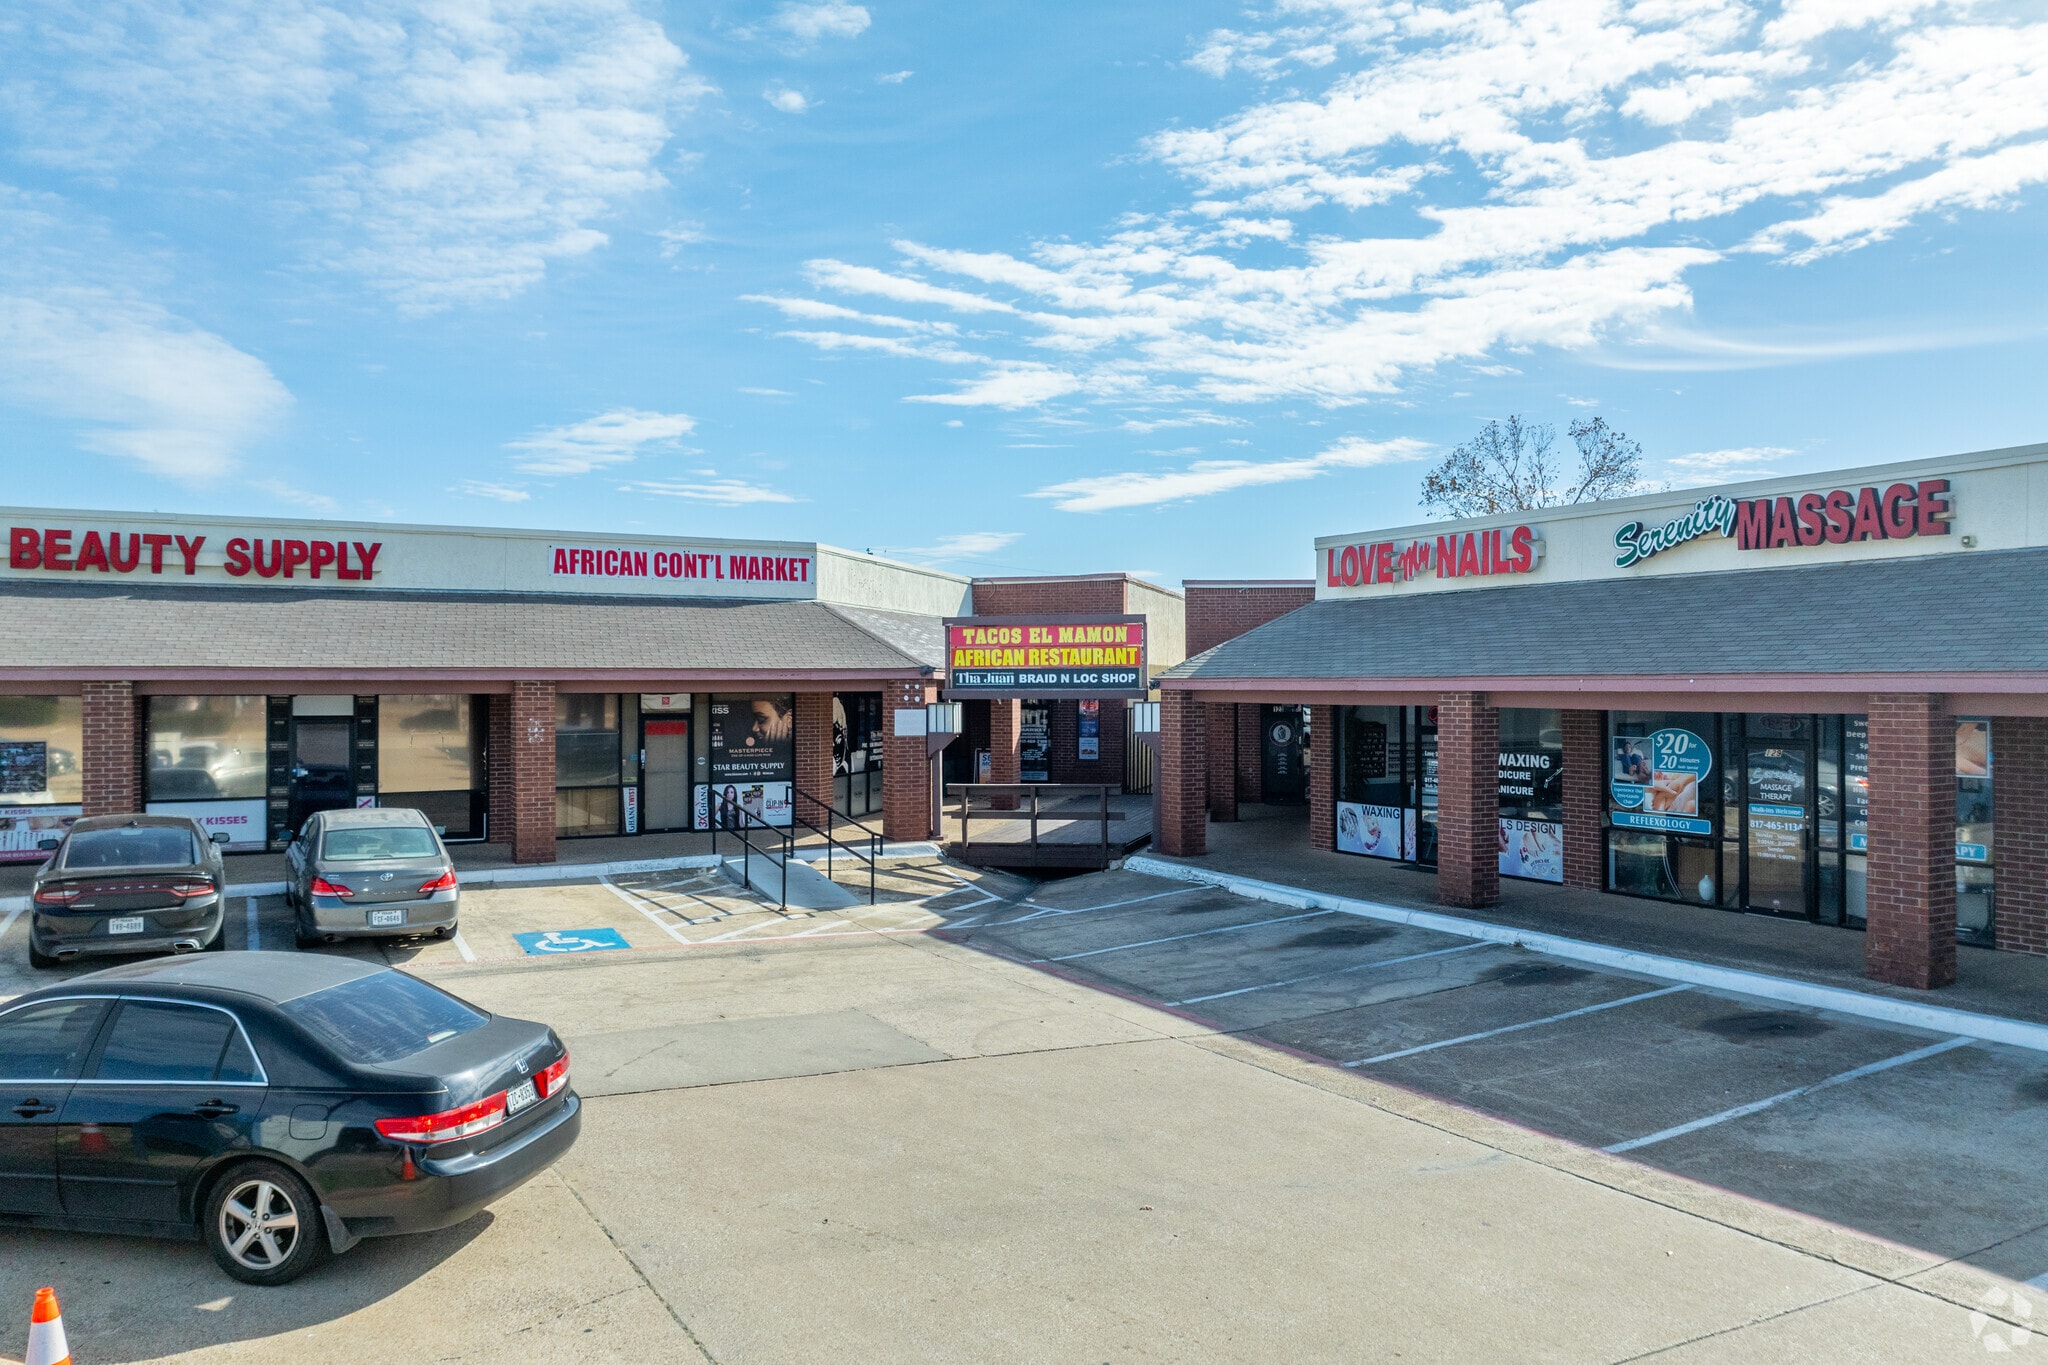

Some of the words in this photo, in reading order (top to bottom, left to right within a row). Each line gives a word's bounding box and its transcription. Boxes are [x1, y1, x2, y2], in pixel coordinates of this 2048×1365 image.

[1614, 494, 1736, 568] Serenity
[1737, 479, 1950, 550] MASSAGE
[10, 527, 207, 576] BEAUTY
[223, 537, 383, 581] SUPPLY
[1327, 542, 1396, 588] LOVE
[1436, 525, 1536, 579] NAILS
[553, 548, 648, 577] AFRICAN
[653, 551, 725, 580] CONT'L
[729, 555, 810, 583] MARKET
[962, 627, 1022, 645] TACOS
[1029, 627, 1053, 644] EL
[1058, 626, 1128, 644] MAMON
[953, 648, 1025, 667] AFRICAN
[1029, 647, 1138, 667] RESTAURANT
[955, 672, 981, 684] Tha
[984, 672, 1015, 684] Juan
[1018, 673, 1058, 684] BRAID
[1060, 673, 1070, 683] N
[1073, 673, 1099, 684] LOC
[1101, 673, 1137, 684] SHOP
[1846, 731, 1866, 739] Deep
[1656, 733, 1689, 755] $20
[731, 763, 759, 771] BEAUTY
[760, 762, 785, 770] SUPPLY
[1658, 755, 1677, 769] 20
[1760, 783, 1792, 792] MASSAGE
[1760, 792, 1792, 800] THERAPY
[628, 806, 636, 832] GHANA
[1361, 805, 1400, 819] WAXING
[206, 816, 248, 826] KISSES
[1516, 821, 1556, 835] DESIGN
[1629, 815, 1691, 829] REFLEXOLOGY
